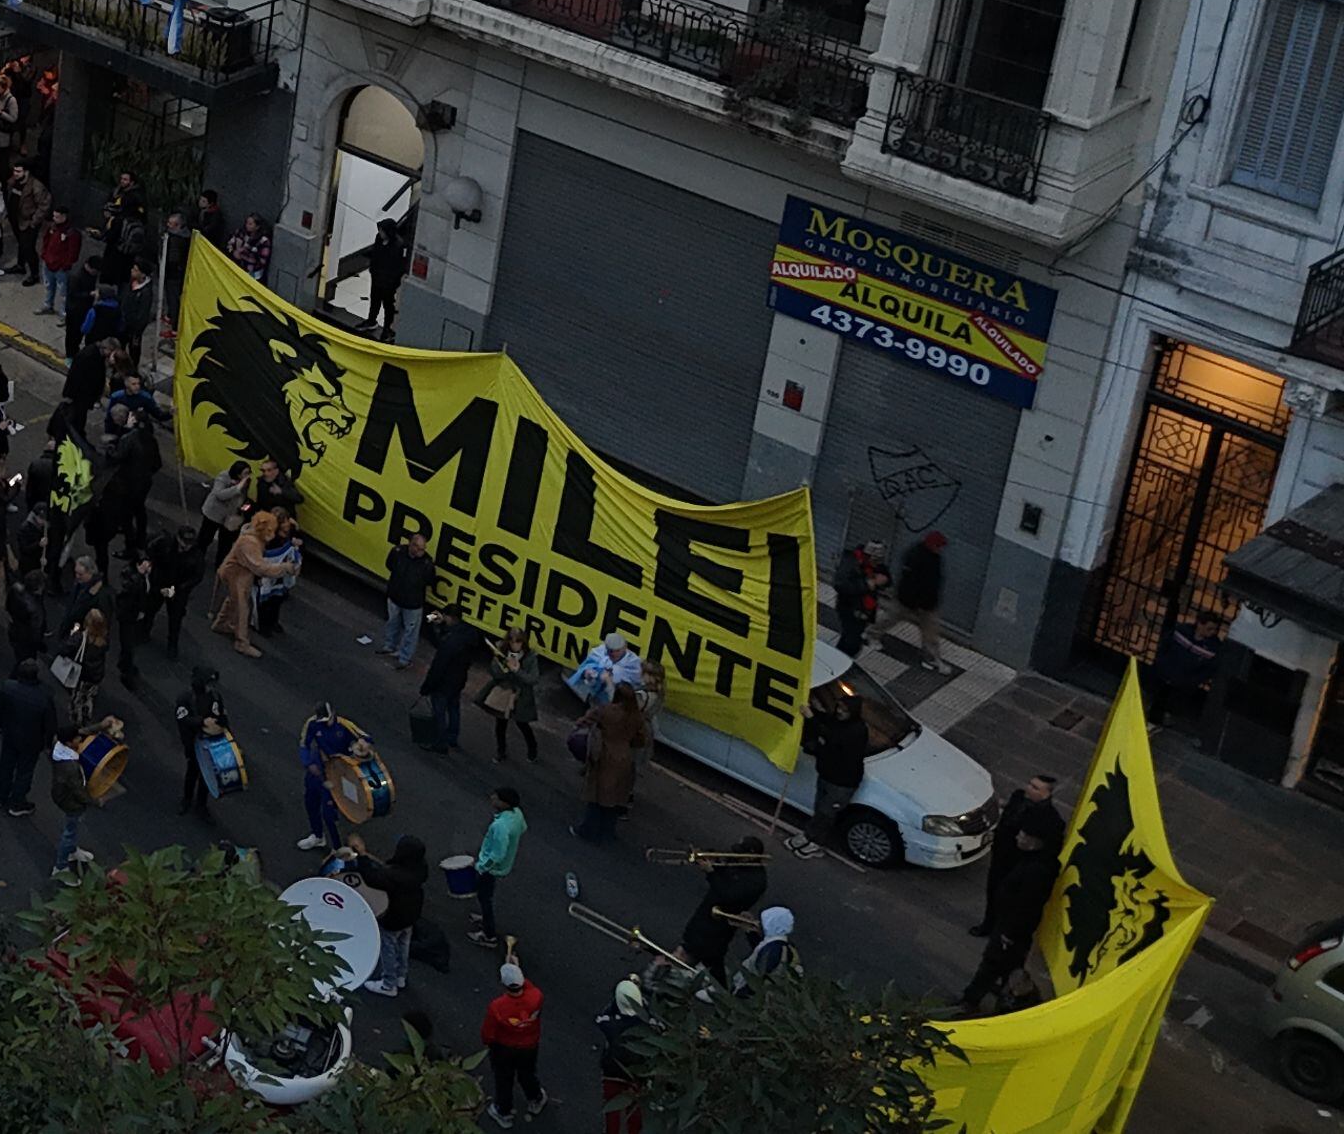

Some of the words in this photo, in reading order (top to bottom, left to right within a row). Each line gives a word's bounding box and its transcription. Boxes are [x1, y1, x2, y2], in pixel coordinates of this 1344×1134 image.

[771, 261, 856, 281] ALQUILADO
[804, 238, 867, 267] GRUPO
[875, 262, 1025, 326] INMOBILIARIO
[805, 207, 1030, 312] MOSQUERA
[810, 304, 991, 386] 4373-9990
[839, 282, 973, 346] ALQUILA
[974, 315, 1037, 376] ALQUILADO
[355, 362, 804, 660] MILEI
[343, 477, 799, 727] PRESIDENTE
